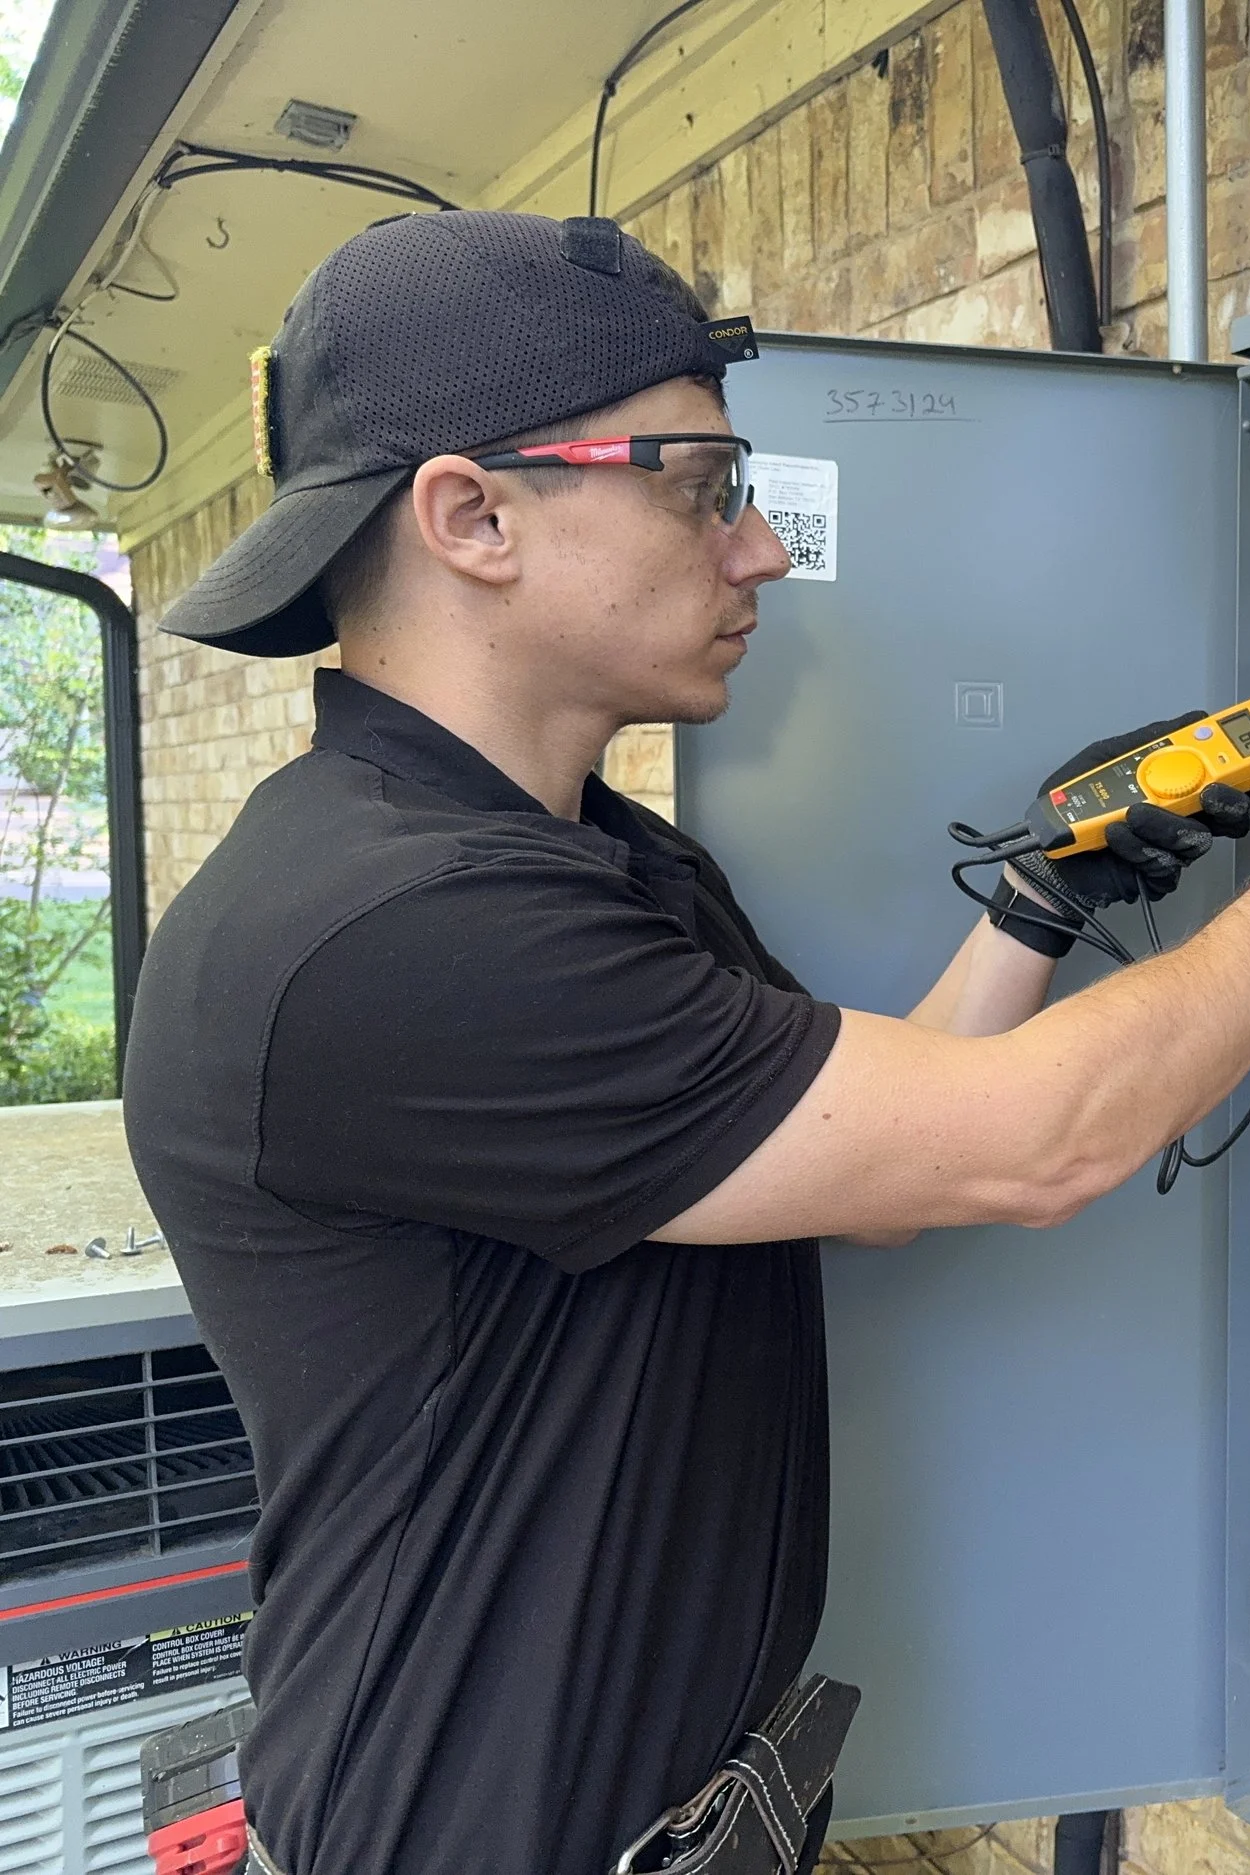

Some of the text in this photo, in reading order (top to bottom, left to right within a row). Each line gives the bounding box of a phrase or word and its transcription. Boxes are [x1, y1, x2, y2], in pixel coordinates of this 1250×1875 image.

[709, 327, 748, 340] CONDOR
[1128, 783, 1138, 794] OFF
[186, 1614, 240, 1632] CAUTION
[58, 1641, 121, 1661] WARNING
[152, 1629, 225, 1652] CONTROL BOX COVER!
[152, 1649, 179, 1660] CONTROL
[181, 1645, 193, 1654] BOX
[194, 1641, 213, 1651] COVER
[215, 1637, 230, 1646] MUST
[152, 1658, 171, 1667] PLACE
[172, 1653, 190, 1663] WHEN
[191, 1648, 214, 1659] SYSTEM
[222, 1641, 243, 1651] OPERAT
[12, 1656, 105, 1685] HAZARDOUS VOLTAGE!
[12, 1661, 127, 1694] DISCONNECT ALL ELECTRIC POWER
[152, 1667, 172, 1676] Failure
[180, 1661, 199, 1670] replace
[200, 1656, 218, 1666] control
[153, 1676, 168, 1685] result
[176, 1667, 199, 1680] personal
[12, 1669, 126, 1702] INCLUDING REMOTE DISCONNECTS
[12, 1699, 39, 1710] BEFORE
[13, 1682, 144, 1718] Failure to disconnect power before servicing
[26, 1714, 44, 1723] cause
[45, 1709, 66, 1719] severe
[67, 1701, 94, 1715] personal
[94, 1697, 112, 1709] injury
